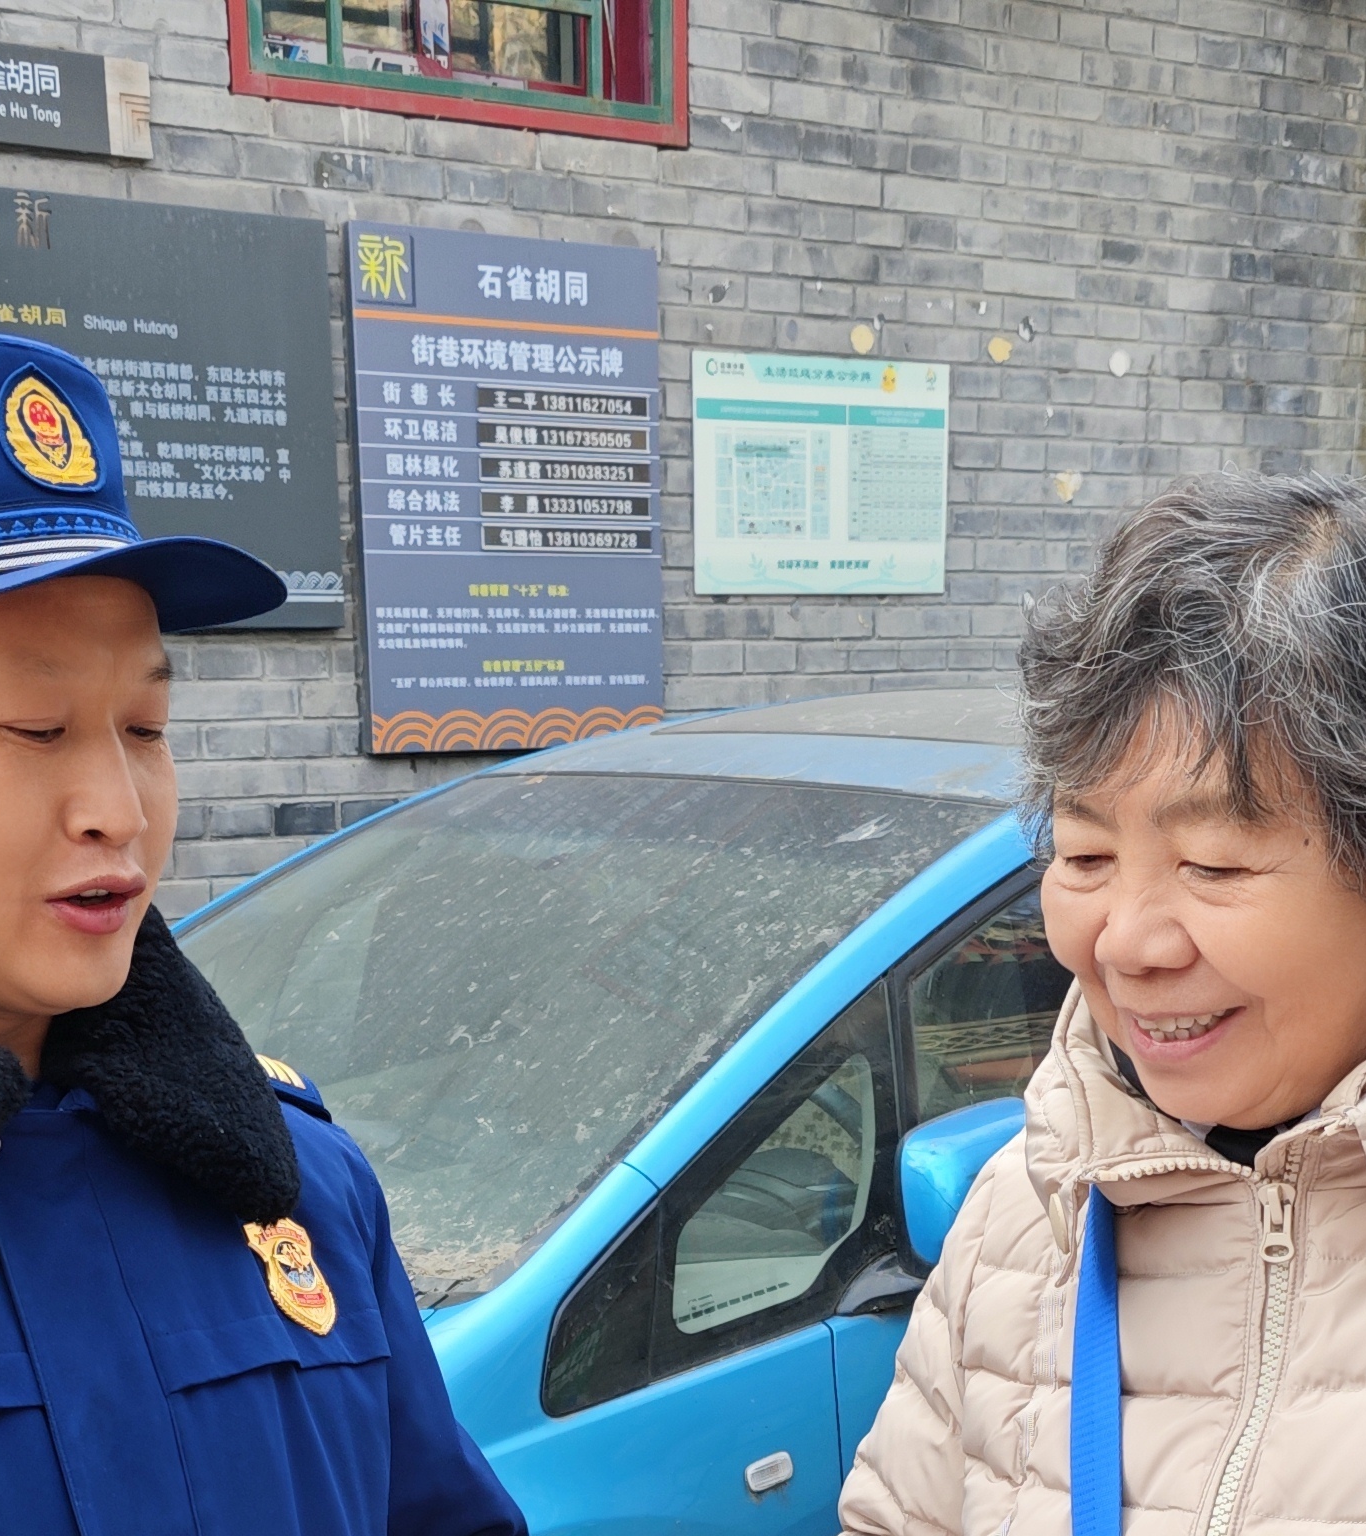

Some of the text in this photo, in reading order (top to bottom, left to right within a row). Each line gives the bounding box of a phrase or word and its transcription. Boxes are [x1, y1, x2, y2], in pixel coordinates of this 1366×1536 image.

[10, 101, 28, 120] Hu
[31, 104, 61, 128] Tong
[477, 264, 588, 306] 石雀胡同
[83, 314, 179, 339] Shique Hutong
[411, 335, 623, 378] 街巷环境管理公示牌
[384, 418, 458, 443] 环卫保洁
[386, 454, 460, 478] 园林绿化
[387, 489, 461, 513] 综合执法
[389, 524, 462, 548] 管片主任
